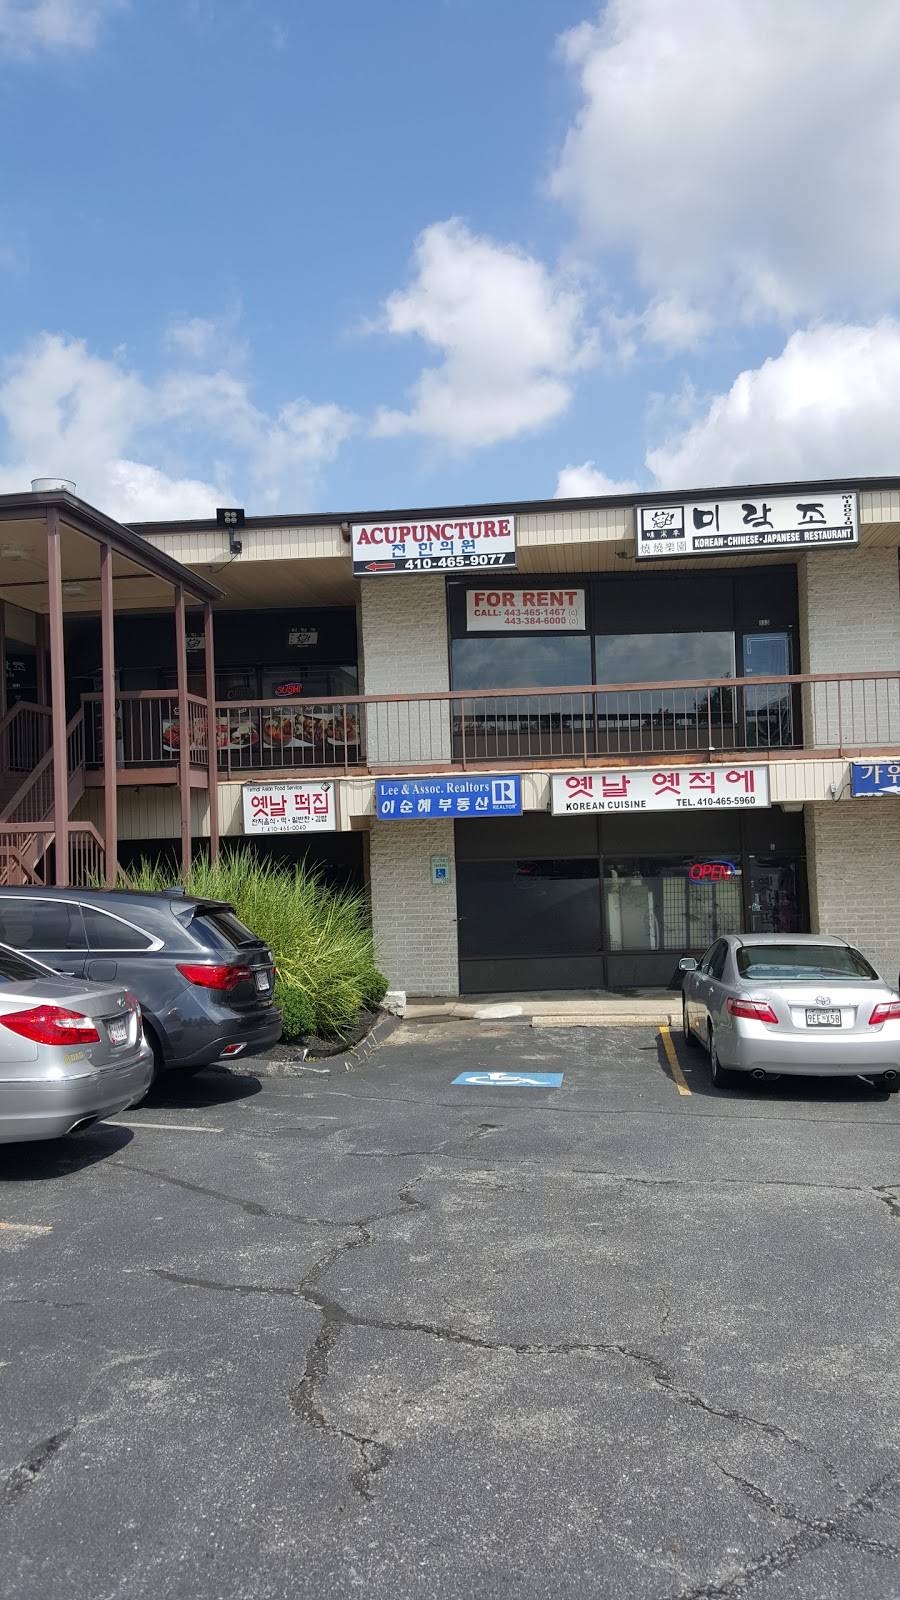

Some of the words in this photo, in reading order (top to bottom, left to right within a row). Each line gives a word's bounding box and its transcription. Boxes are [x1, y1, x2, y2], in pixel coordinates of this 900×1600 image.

[357, 519, 511, 545] ACUPUNCTURE
[804, 528, 852, 541] RESTAURANT
[405, 553, 506, 570] 410-465-9077
[474, 591, 516, 607] FOR
[522, 591, 578, 607] RENT
[474, 609, 502, 617] CALL:
[504, 617, 566, 625] 443-384-6000
[276, 683, 303, 695] SUSHI
[380, 784, 399, 796] Lee
[401, 783, 410, 795] &
[412, 783, 444, 795] Assoc.
[446, 781, 489, 794] Realtors
[565, 775, 631, 799] 옛날
[651, 769, 755, 796] 옛적에
[251, 794, 287, 817] 옛날
[294, 792, 329, 815] 떡집
[438, 796, 489, 812] 부동산
[565, 801, 605, 811] KOREAN
[607, 800, 647, 809] CUISINE
[676, 798, 696, 807] TEL.
[697, 796, 756, 806] 410-465-5960
[689, 863, 732, 881] OPEN
